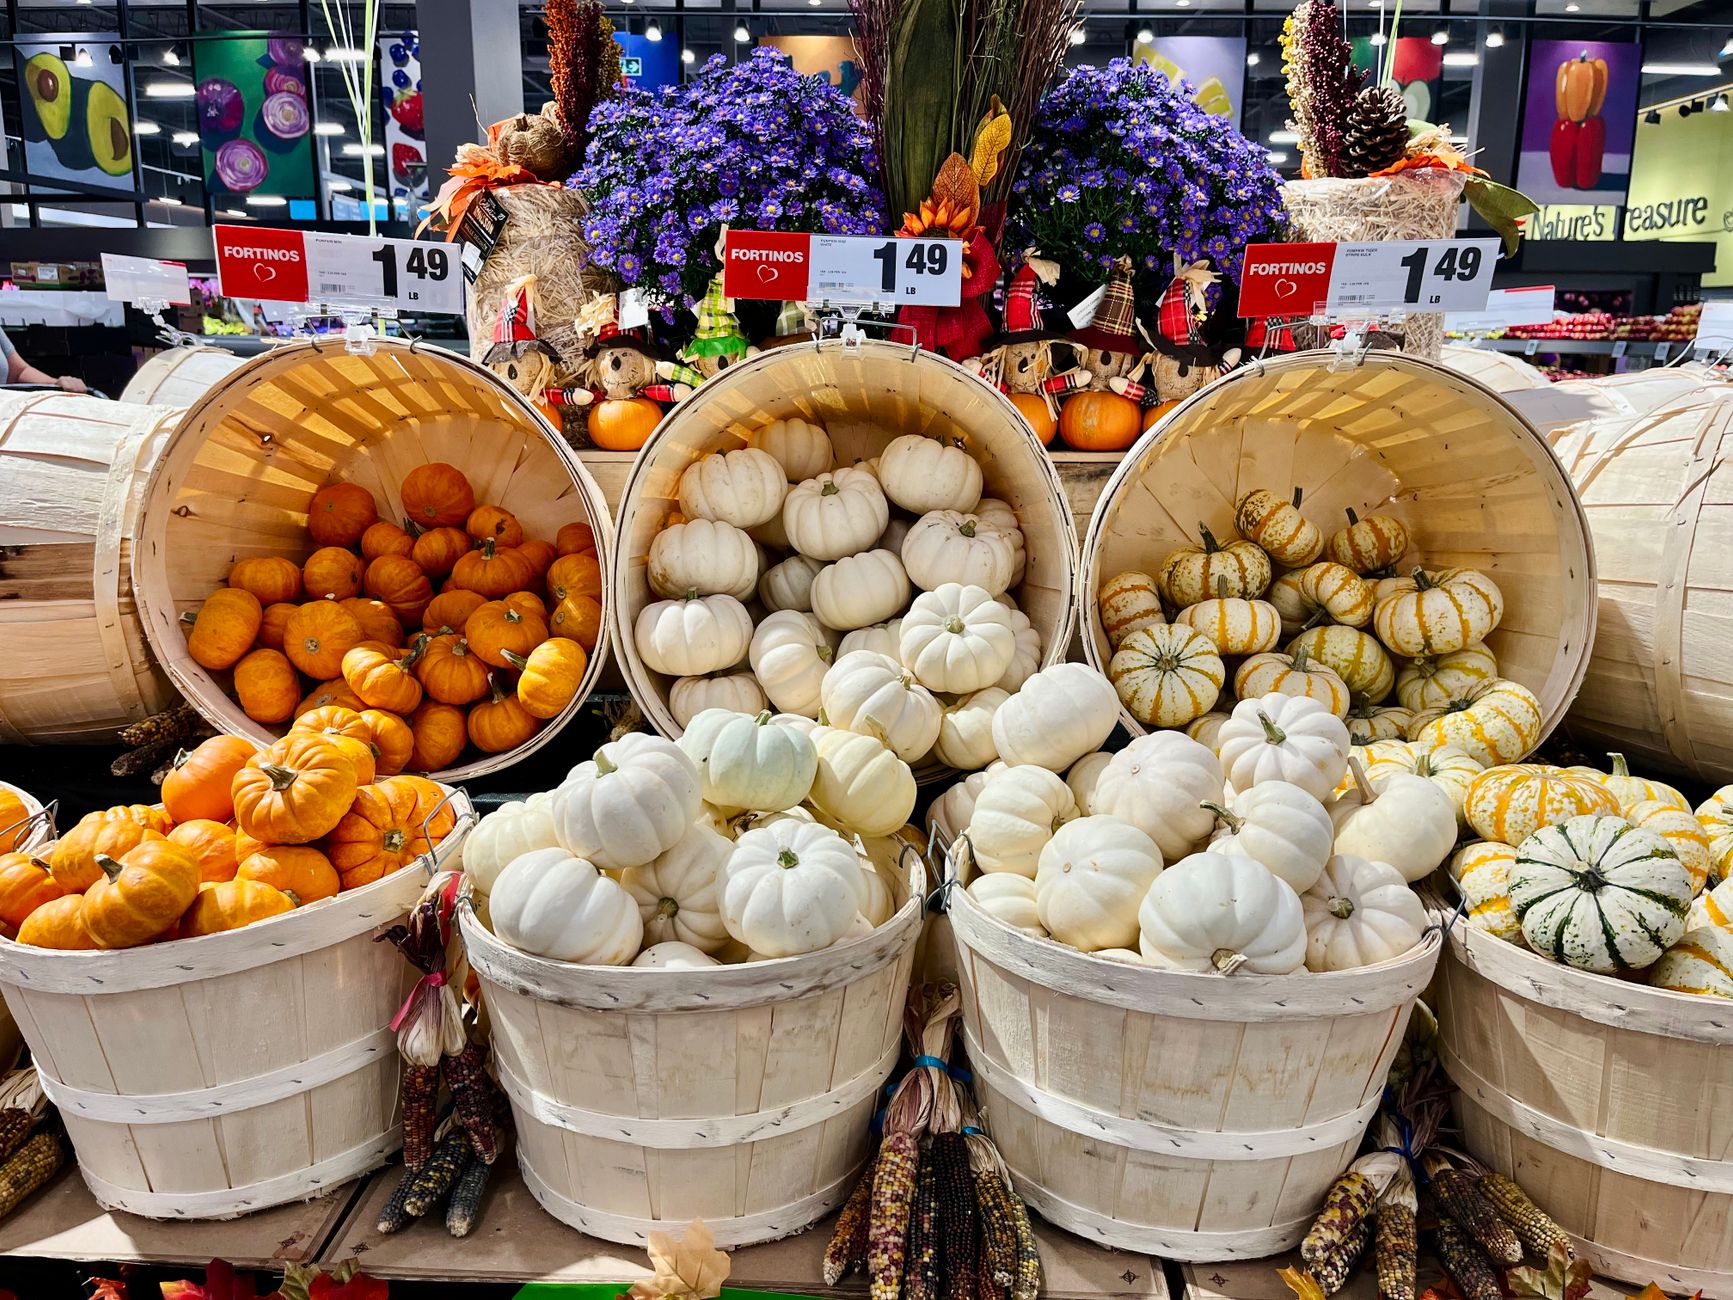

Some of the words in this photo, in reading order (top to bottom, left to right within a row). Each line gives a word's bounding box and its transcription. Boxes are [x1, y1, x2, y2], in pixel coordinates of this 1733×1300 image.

[1626, 197, 1708, 232] easure
[224, 246, 300, 262] FORTINOS
[731, 248, 804, 263] FORTINOS
[372, 244, 398, 298] 1
[406, 247, 448, 281] 49
[874, 242, 897, 293] 1
[905, 243, 948, 276] 49
[1249, 262, 1327, 276] FORTINOS
[1400, 247, 1429, 304] 1
[1433, 246, 1482, 282] 49
[409, 292, 419, 300] LB
[906, 287, 917, 295] LB
[1429, 295, 1441, 304] LB
